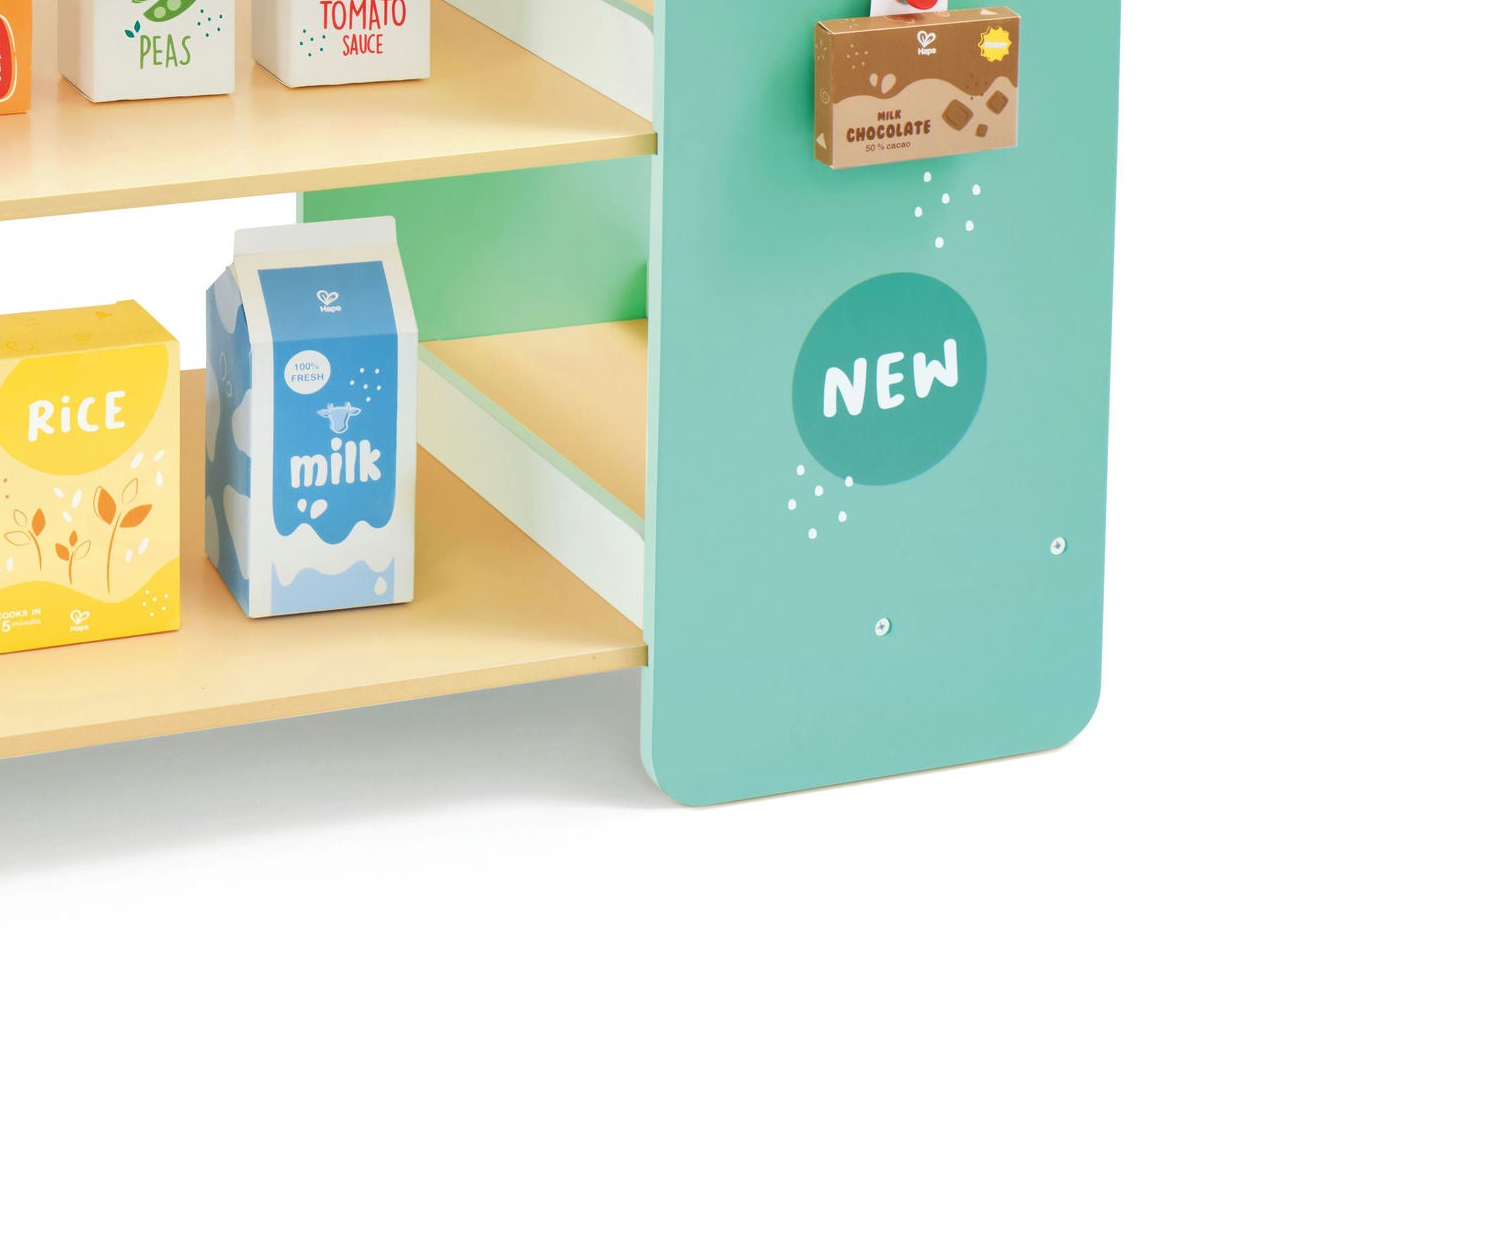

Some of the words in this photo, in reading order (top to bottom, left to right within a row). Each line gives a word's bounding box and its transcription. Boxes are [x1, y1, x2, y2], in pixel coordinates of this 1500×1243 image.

[139, 33, 192, 70] PEAS
[342, 33, 384, 57] SAUCE
[917, 47, 937, 56] Hape
[877, 109, 902, 122] MILK
[846, 119, 931, 143] CHOCOLATE
[886, 141, 911, 151] cacao
[294, 362, 320, 371] 100%
[291, 373, 325, 383] FRESH
[823, 338, 959, 418] NEW
[290, 437, 381, 489] milk
[31, 607, 42, 615] IN
